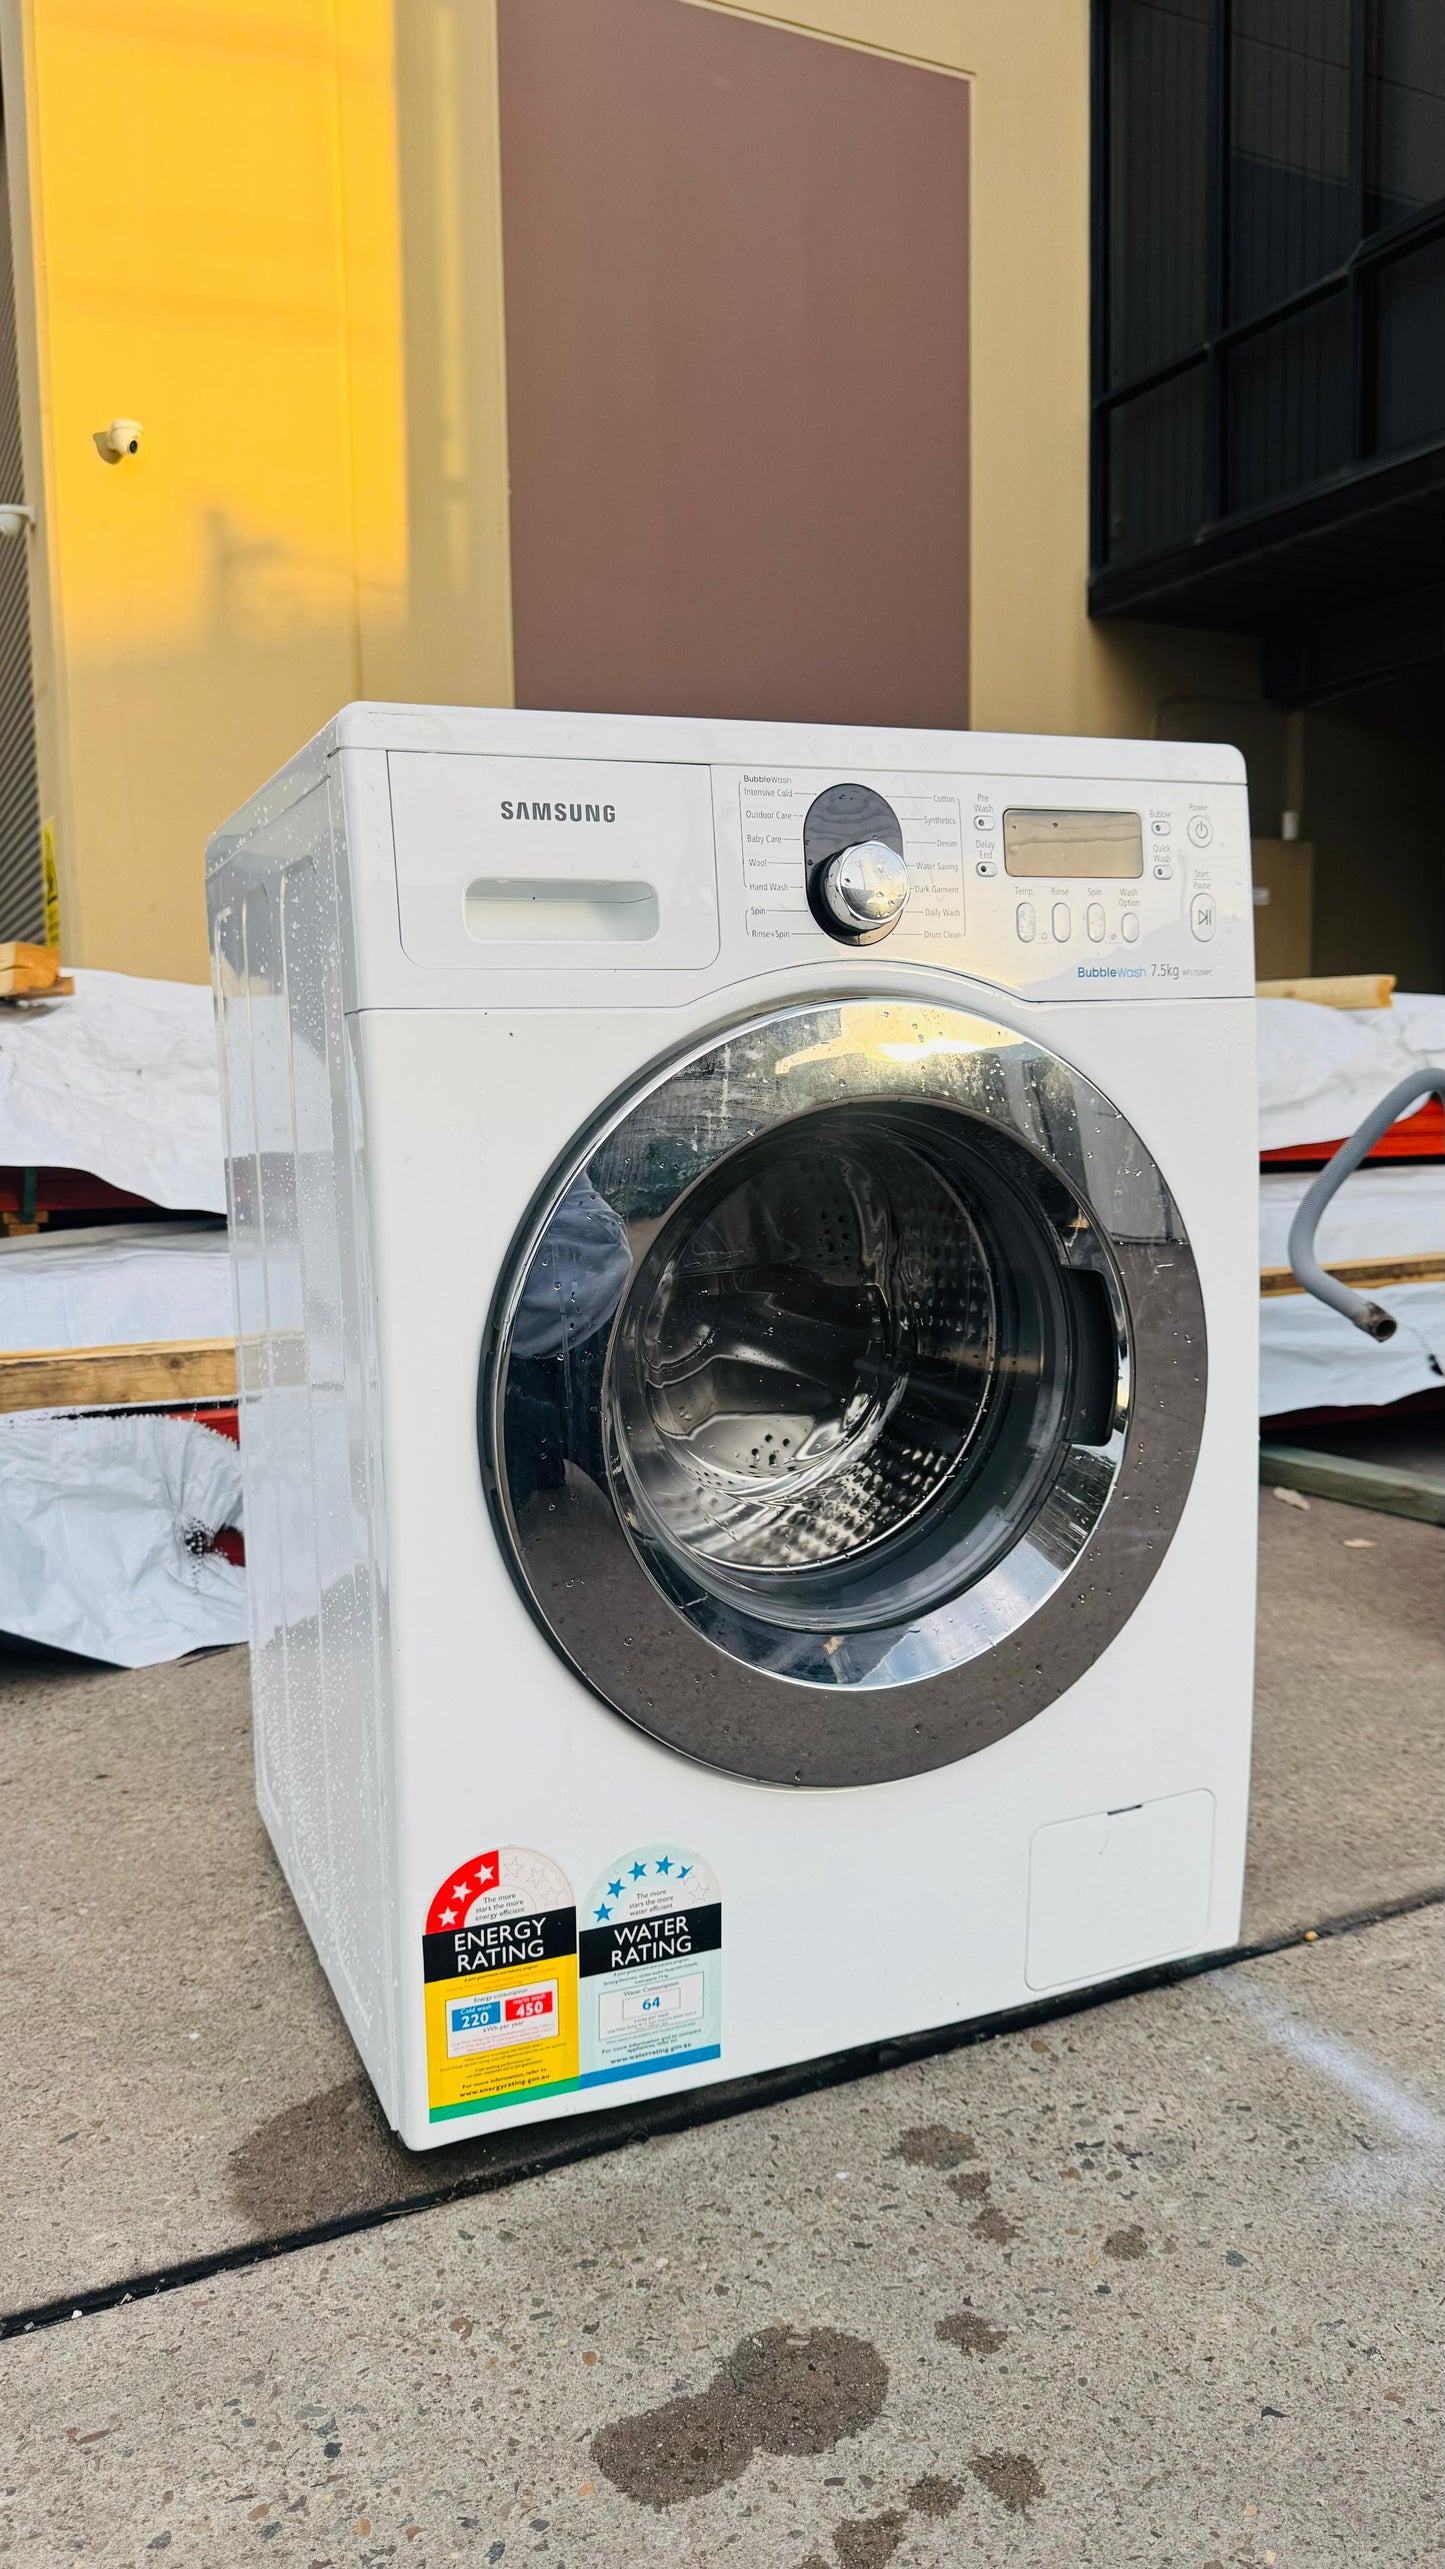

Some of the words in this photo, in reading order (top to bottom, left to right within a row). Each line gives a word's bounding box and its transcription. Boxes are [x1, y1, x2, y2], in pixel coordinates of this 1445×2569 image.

[743, 774, 792, 784] BubbleWash
[744, 788, 775, 797] Intensive
[777, 789, 793, 797] Cold
[933, 795, 955, 803] Cotton
[977, 793, 989, 802] Pre
[974, 804, 993, 813] Wash
[1188, 803, 1208, 811] Power
[500, 801, 616, 823] SAMSUNG
[745, 810, 774, 819] Outdoor
[776, 811, 792, 819] Care
[1149, 810, 1171, 818] Bubble
[923, 816, 956, 825] Synthetics
[747, 834, 764, 845] Baby
[765, 835, 782, 843] Care
[976, 840, 994, 850] Delay
[1152, 844, 1170, 853] Quick
[979, 851, 993, 859] End
[1153, 854, 1171, 863] Wash
[748, 859, 767, 867] Wool
[916, 862, 936, 870] Water
[937, 862, 958, 872] Saving
[749, 883, 768, 891] Hand
[769, 883, 789, 891] Wash
[914, 885, 929, 893] Dark
[931, 885, 959, 893] Garment
[1051, 887, 1069, 896] Rinse
[1087, 888, 1102, 897] Spin
[1120, 888, 1138, 897] Wash
[1118, 899, 1140, 908] Option
[750, 906, 766, 916] Spin
[925, 908, 941, 918] Daily
[751, 930, 790, 939] Rinse+Spin
[924, 930, 942, 938] Drum
[943, 931, 961, 939] Clean
[1077, 967, 1147, 978] BubbleWash
[1151, 963, 1179, 980] 7.5kg
[498, 1893, 516, 1901] more
[649, 1889, 667, 1897] more
[656, 1895, 674, 1903] more
[475, 1913, 498, 1921] energy
[499, 1906, 525, 1916] efficient
[630, 1908, 648, 1916] water
[649, 1903, 673, 1912] efficient
[454, 1917, 546, 1952] ENERGY
[613, 1916, 689, 1946] WATER
[457, 1939, 544, 1973] RATING
[611, 1935, 692, 1968] RATING
[642, 1996, 660, 2011] 64
[516, 2001, 544, 2018] 450
[461, 2012, 489, 2029] 220
[459, 2074, 550, 2098] www.energyrating.gov.au
